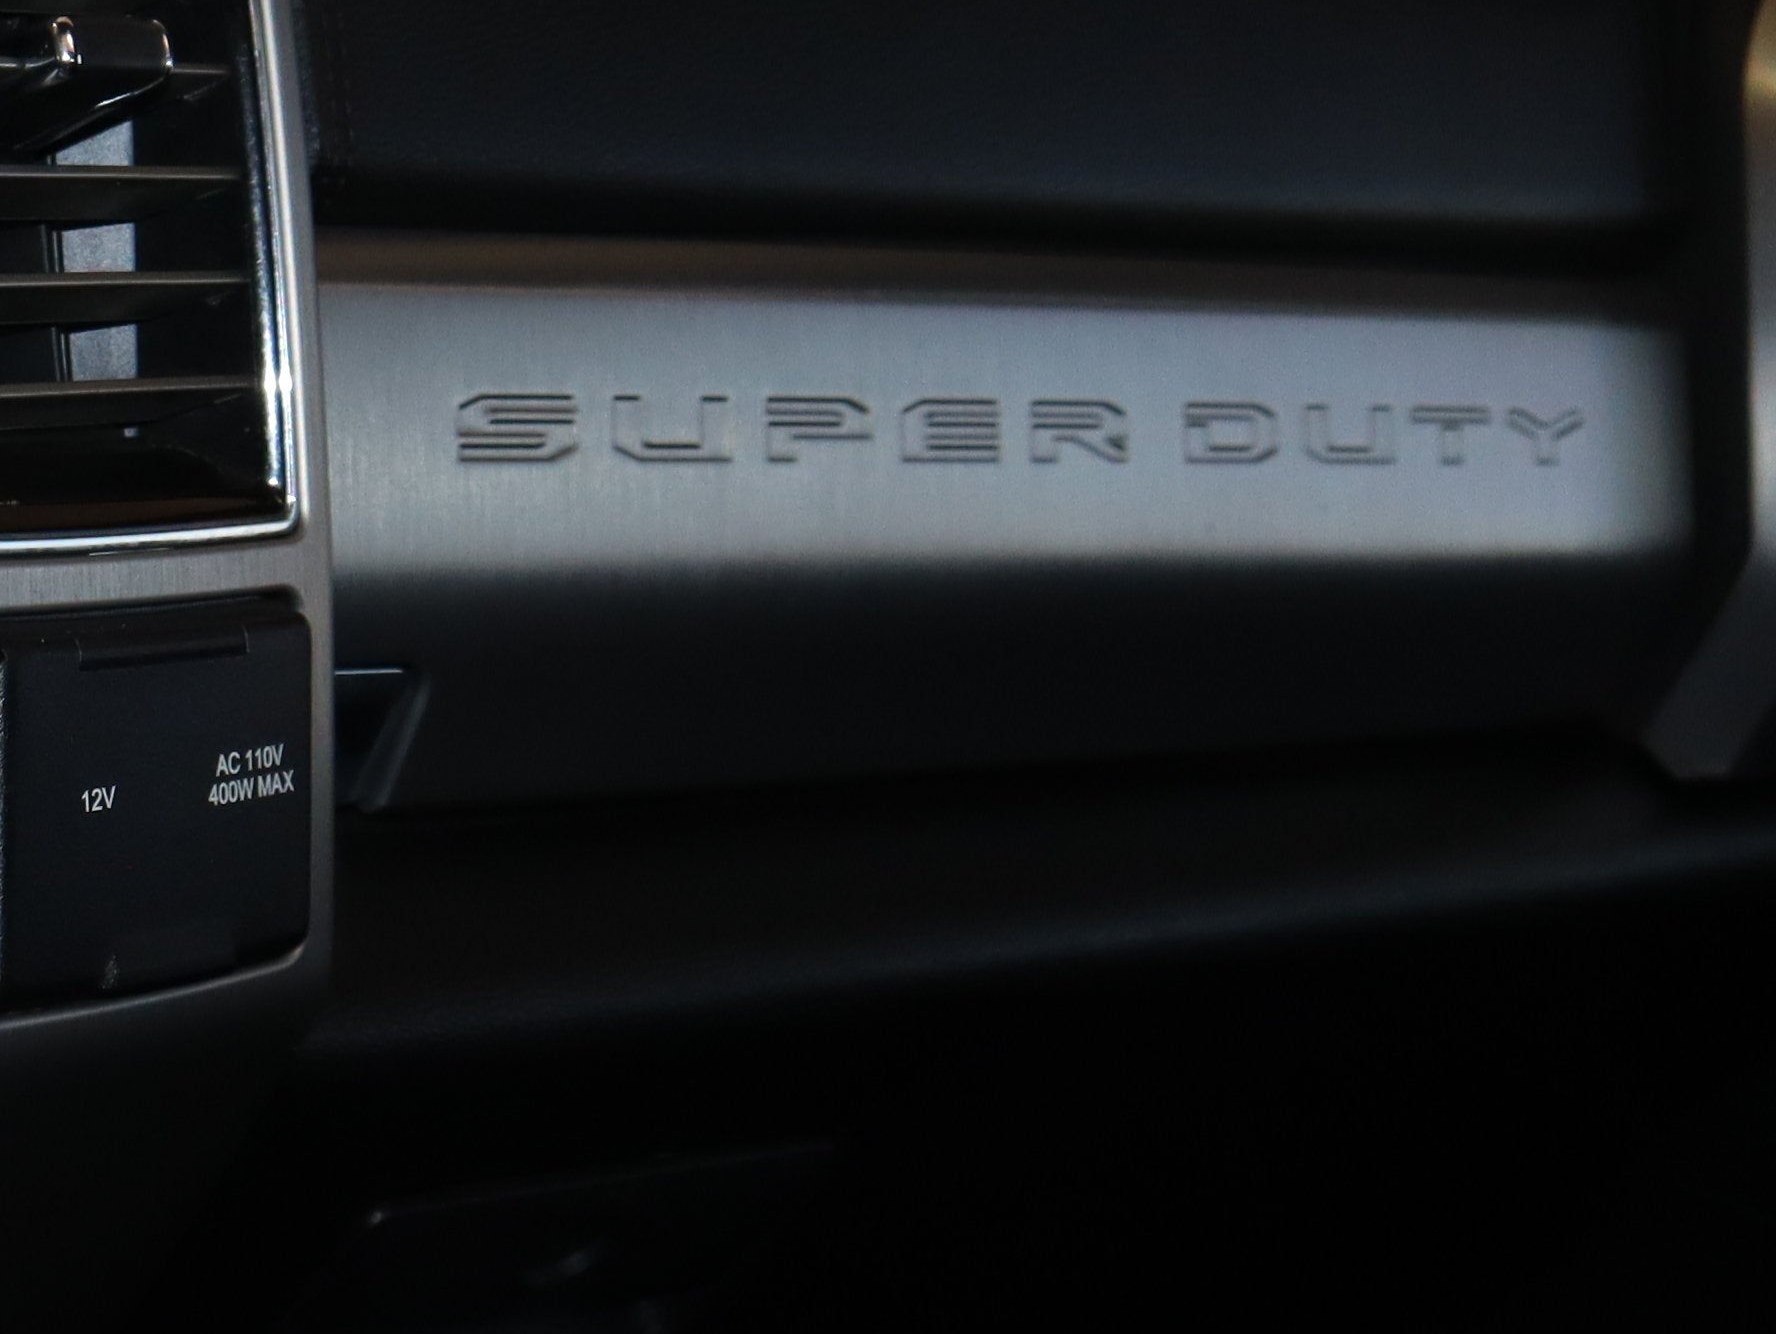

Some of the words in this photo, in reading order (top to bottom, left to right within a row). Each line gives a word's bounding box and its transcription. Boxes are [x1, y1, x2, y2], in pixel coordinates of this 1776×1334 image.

[453, 391, 1130, 467] SUPER
[1180, 399, 1586, 467] DUTY
[215, 751, 241, 777] AC
[245, 743, 284, 771] 110V
[81, 785, 116, 813] 12V
[208, 777, 255, 806] 400W
[257, 769, 295, 798] MAX
